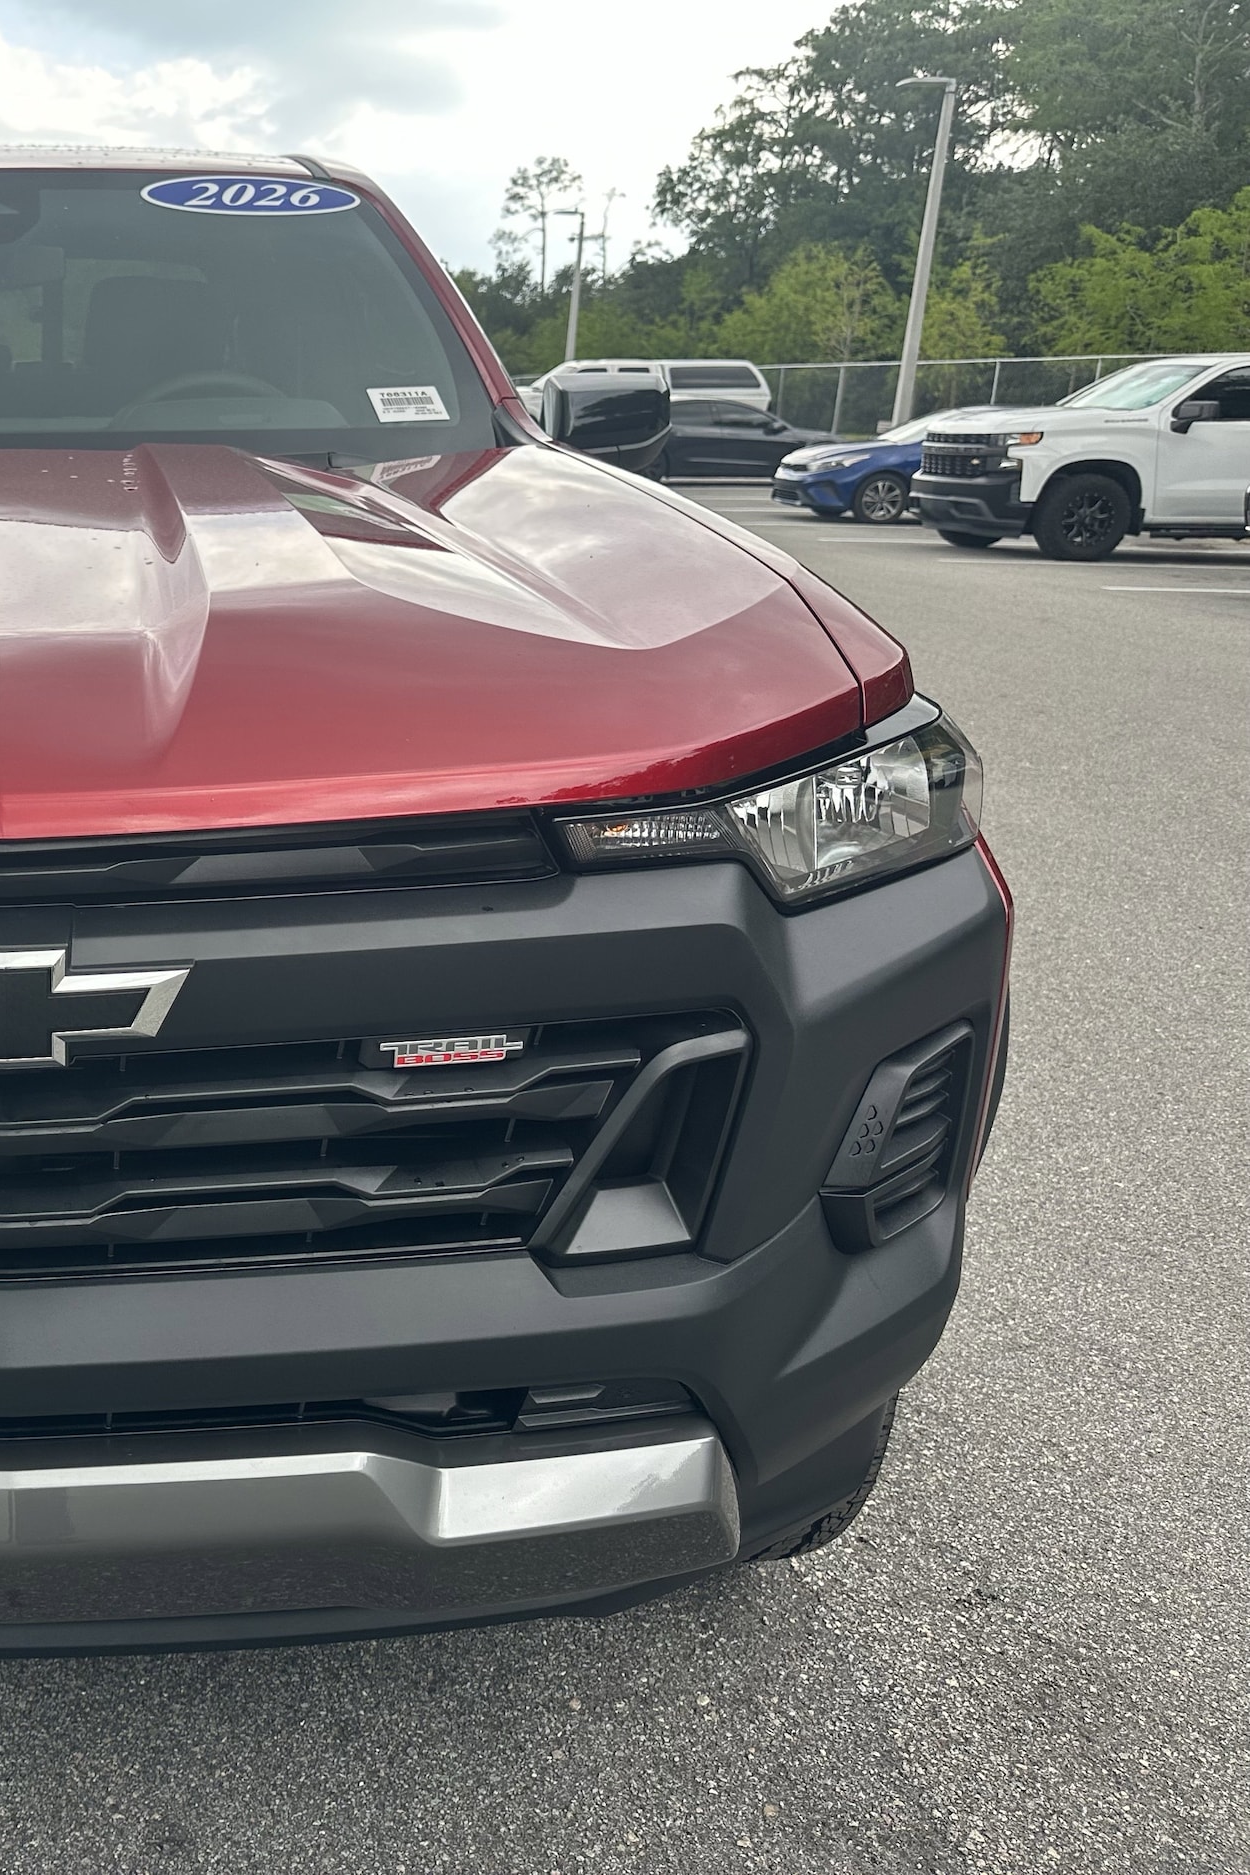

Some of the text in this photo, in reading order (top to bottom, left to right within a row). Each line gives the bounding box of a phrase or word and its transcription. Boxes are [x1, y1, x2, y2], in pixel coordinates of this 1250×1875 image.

[183, 182, 325, 207] 2026
[379, 1034, 524, 1056] TRAIL
[394, 1050, 507, 1068] BOSS
